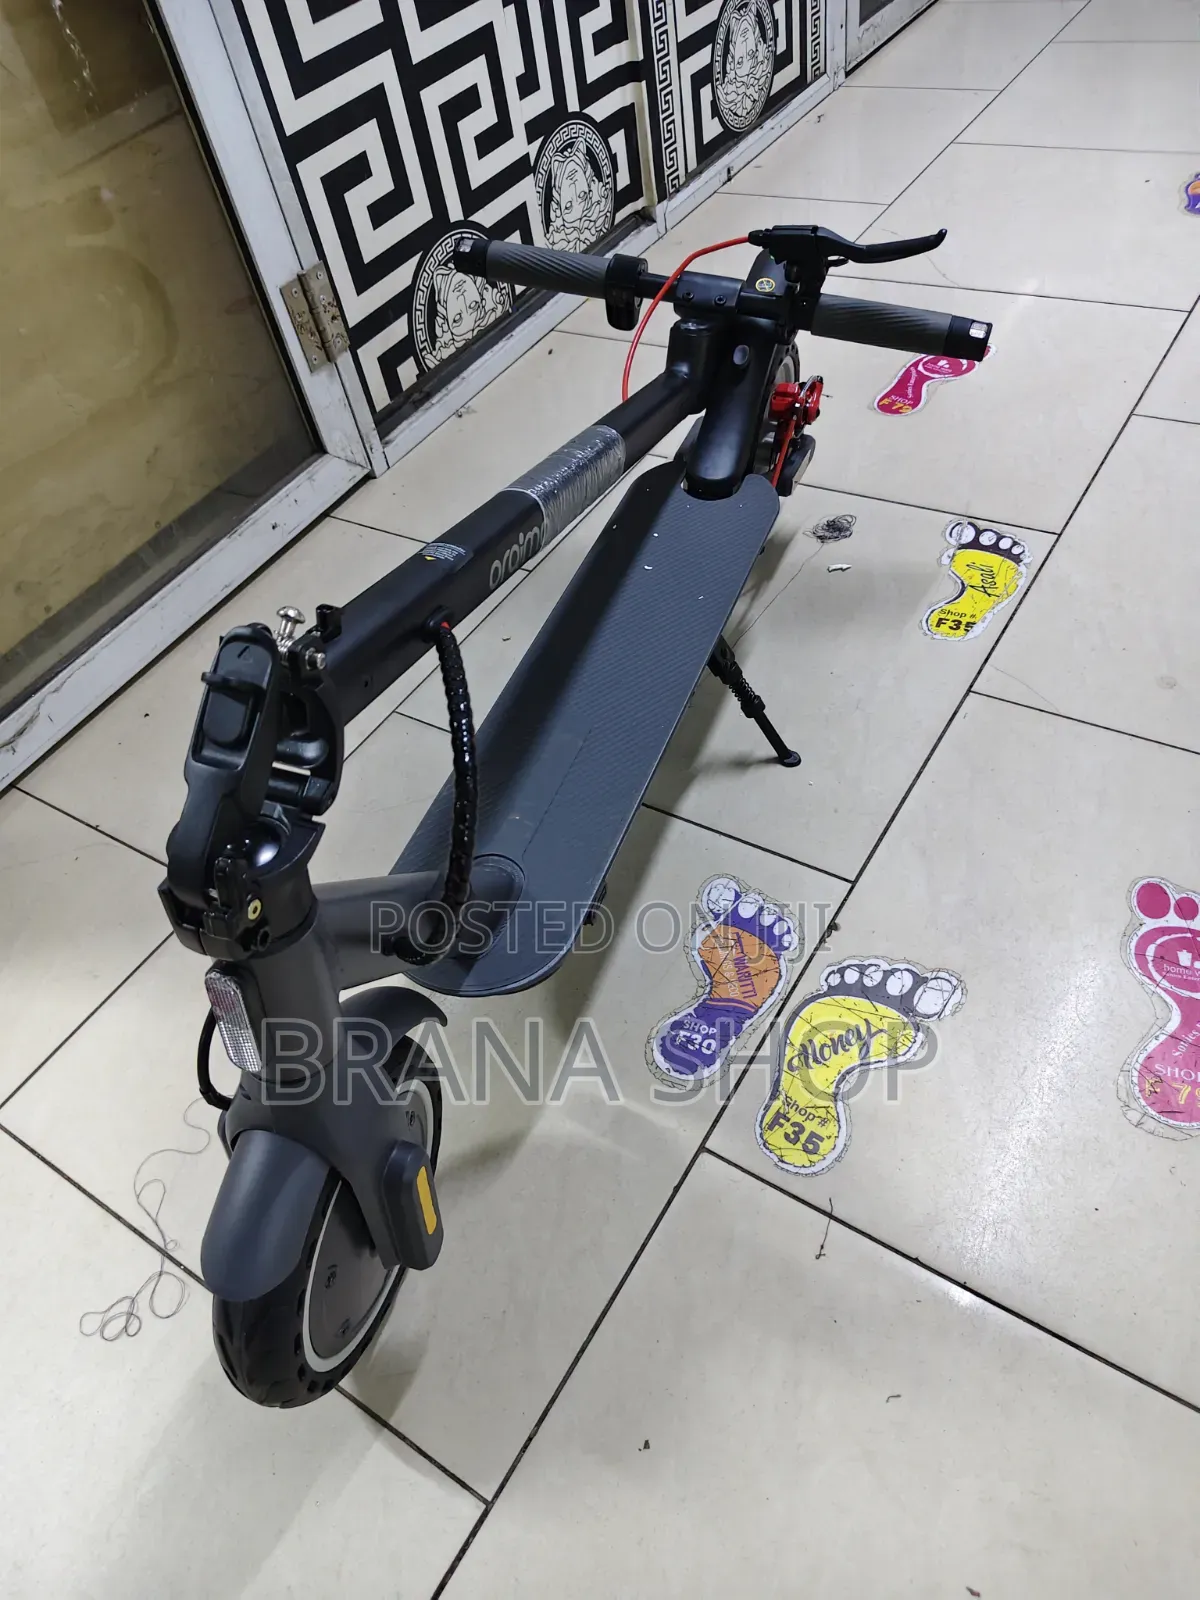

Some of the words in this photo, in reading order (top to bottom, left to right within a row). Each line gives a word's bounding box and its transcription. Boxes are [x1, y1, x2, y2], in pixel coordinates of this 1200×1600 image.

[879, 397, 893, 406] F
[892, 402, 913, 413] 79
[889, 394, 914, 405] SHOP
[965, 561, 1001, 598] Asali
[939, 608, 967, 618] Shop
[683, 1019, 717, 1035] SHOP
[675, 1030, 717, 1055] F30
[1154, 1063, 1200, 1083] SHO
[785, 1094, 816, 1122] Shop
[817, 1116, 829, 1128] #
[767, 1111, 825, 1155] F35
